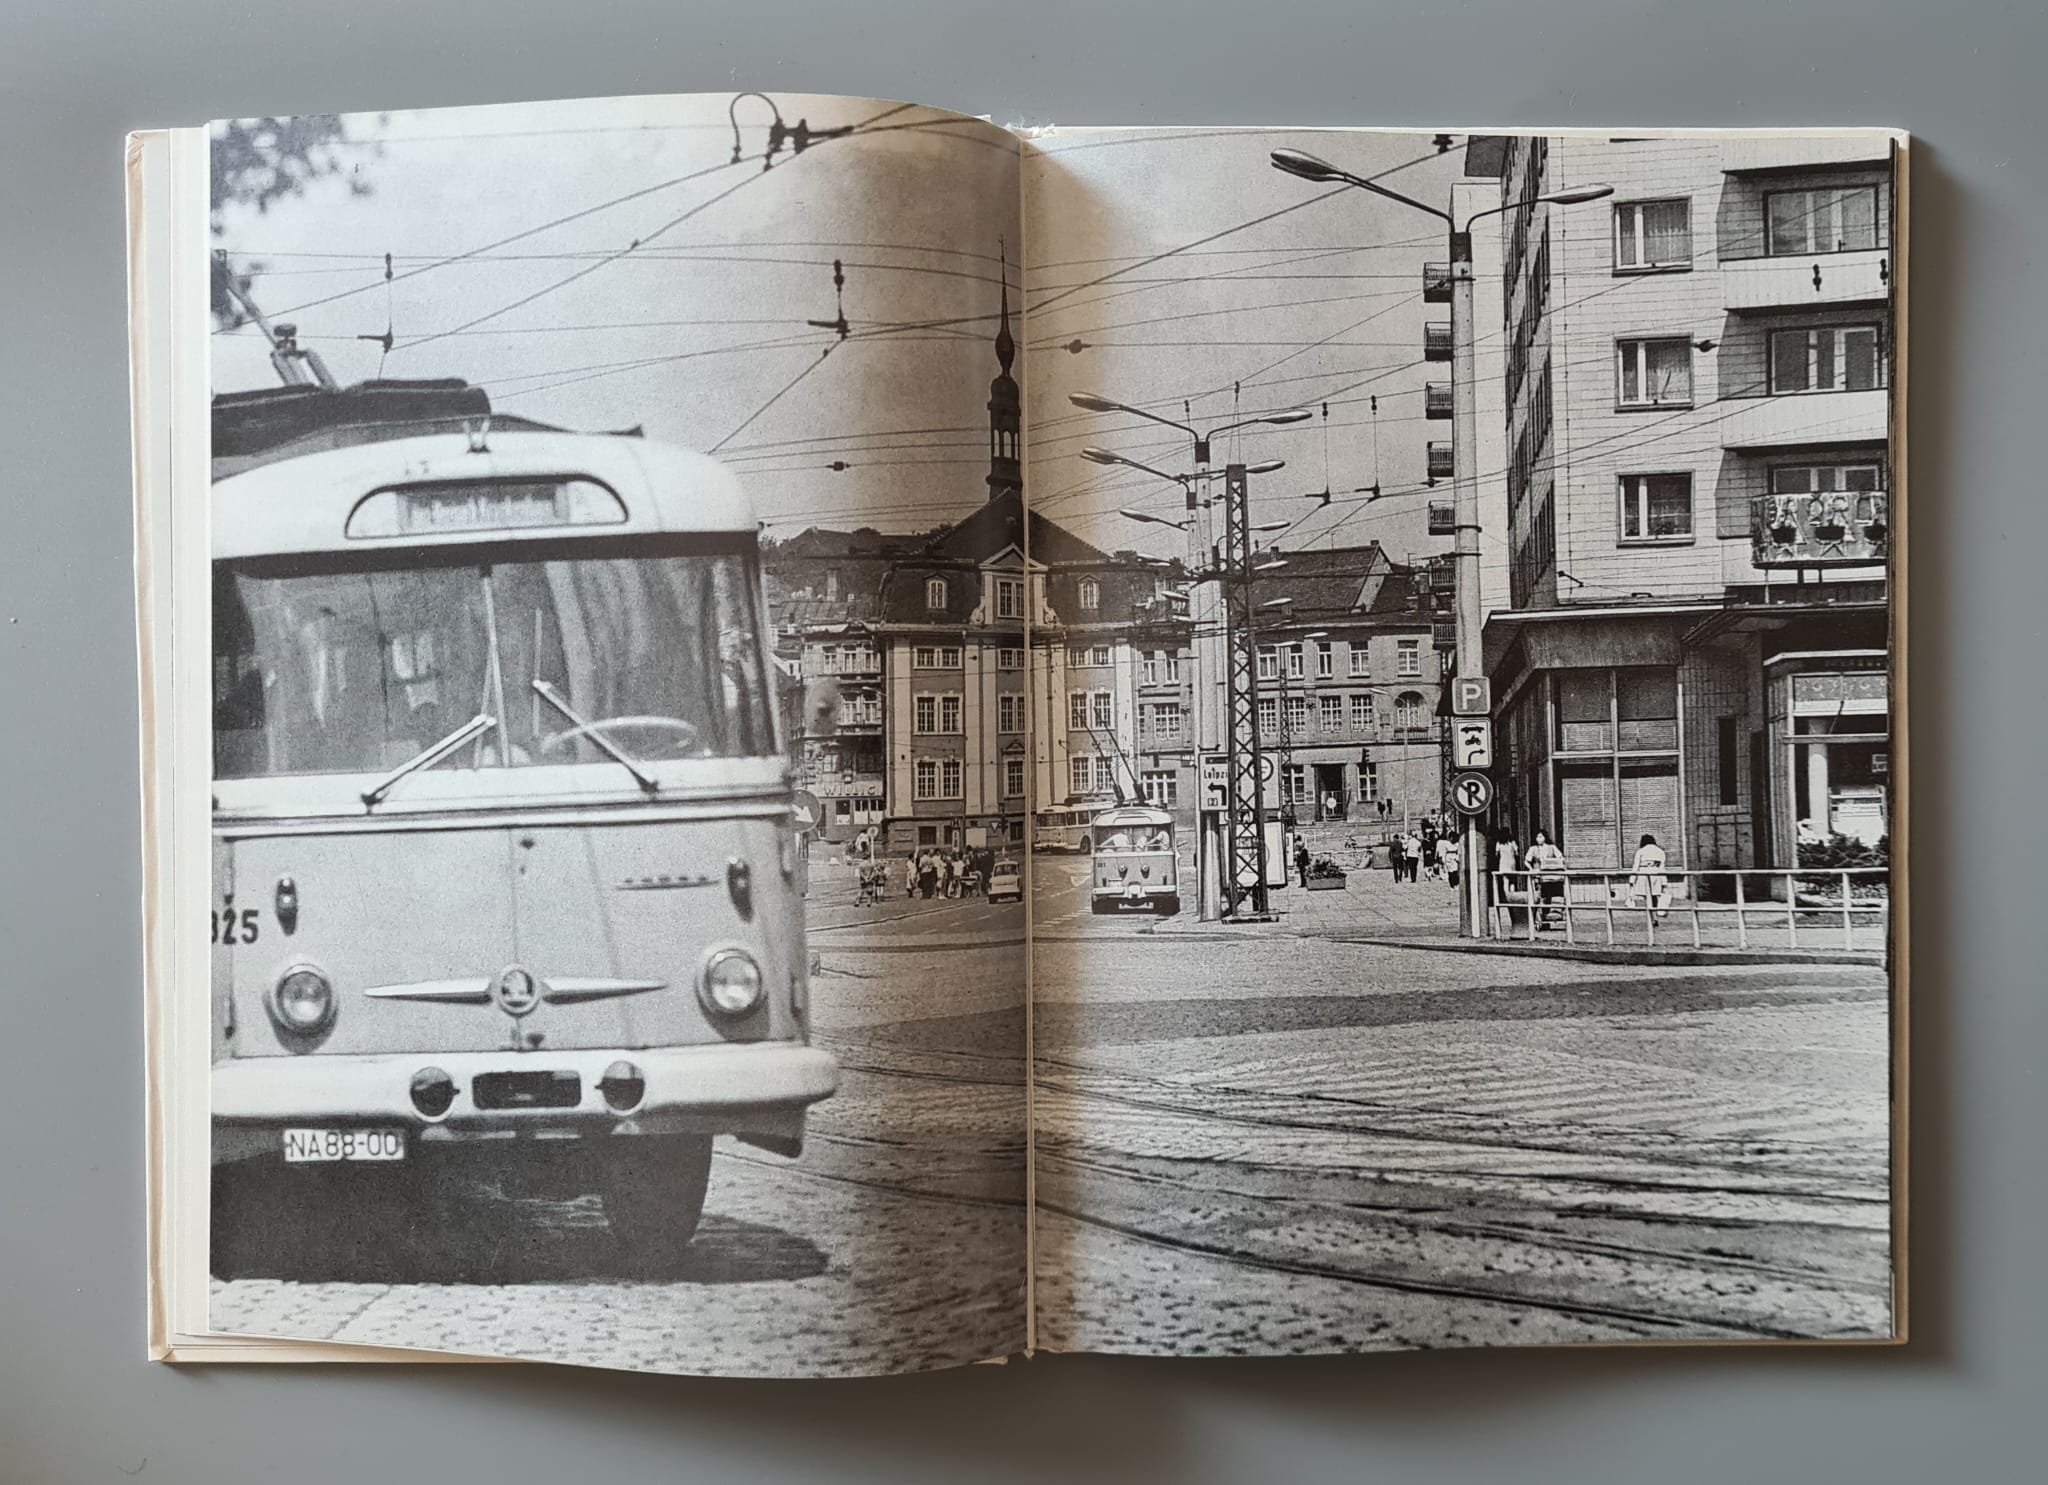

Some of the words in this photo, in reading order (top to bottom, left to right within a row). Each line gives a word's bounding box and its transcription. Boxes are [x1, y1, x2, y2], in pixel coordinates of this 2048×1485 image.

[1461, 683, 1482, 710] P
[1203, 766, 1229, 780] Leipzi
[1466, 781, 1481, 806] P
